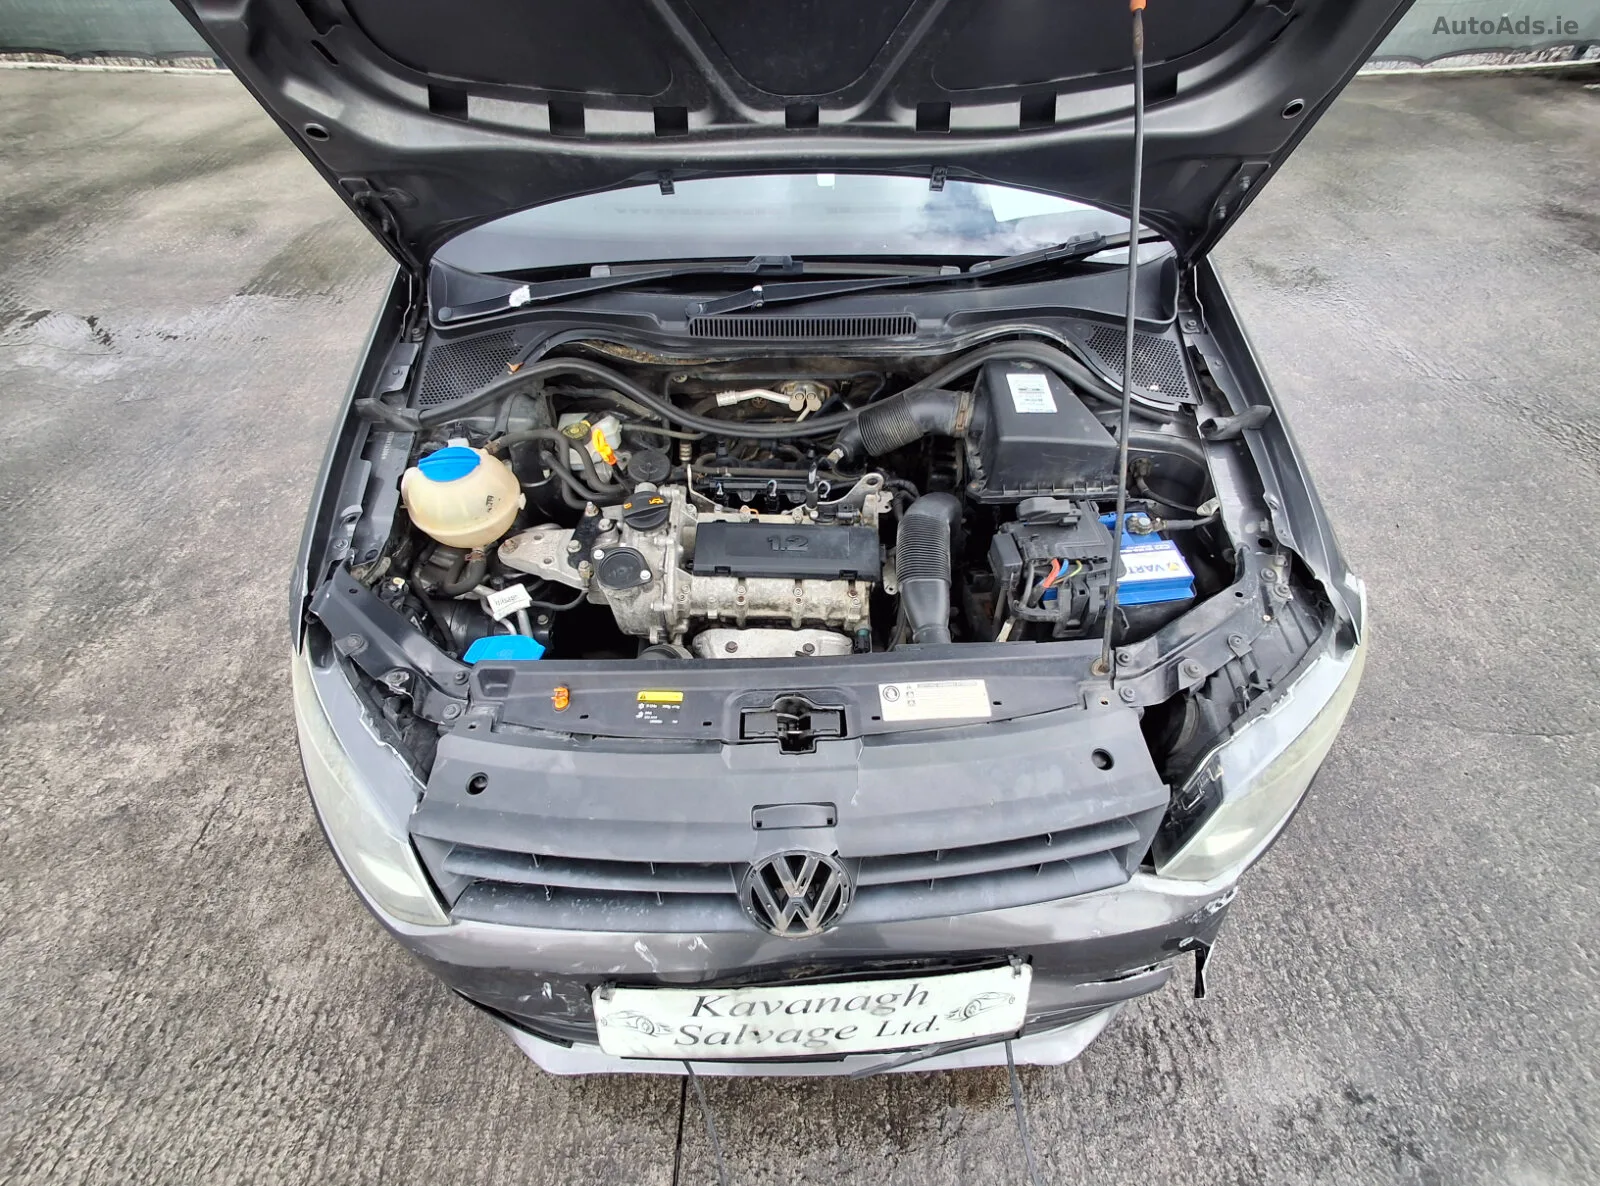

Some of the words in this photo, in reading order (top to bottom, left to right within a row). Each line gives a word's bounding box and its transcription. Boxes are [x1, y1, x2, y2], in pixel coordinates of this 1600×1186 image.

[767, 534, 809, 552] 1.2
[689, 983, 929, 1018] Kavanagh
[673, 1023, 858, 1048] Salvage
[873, 1014, 940, 1038] Ltd.
